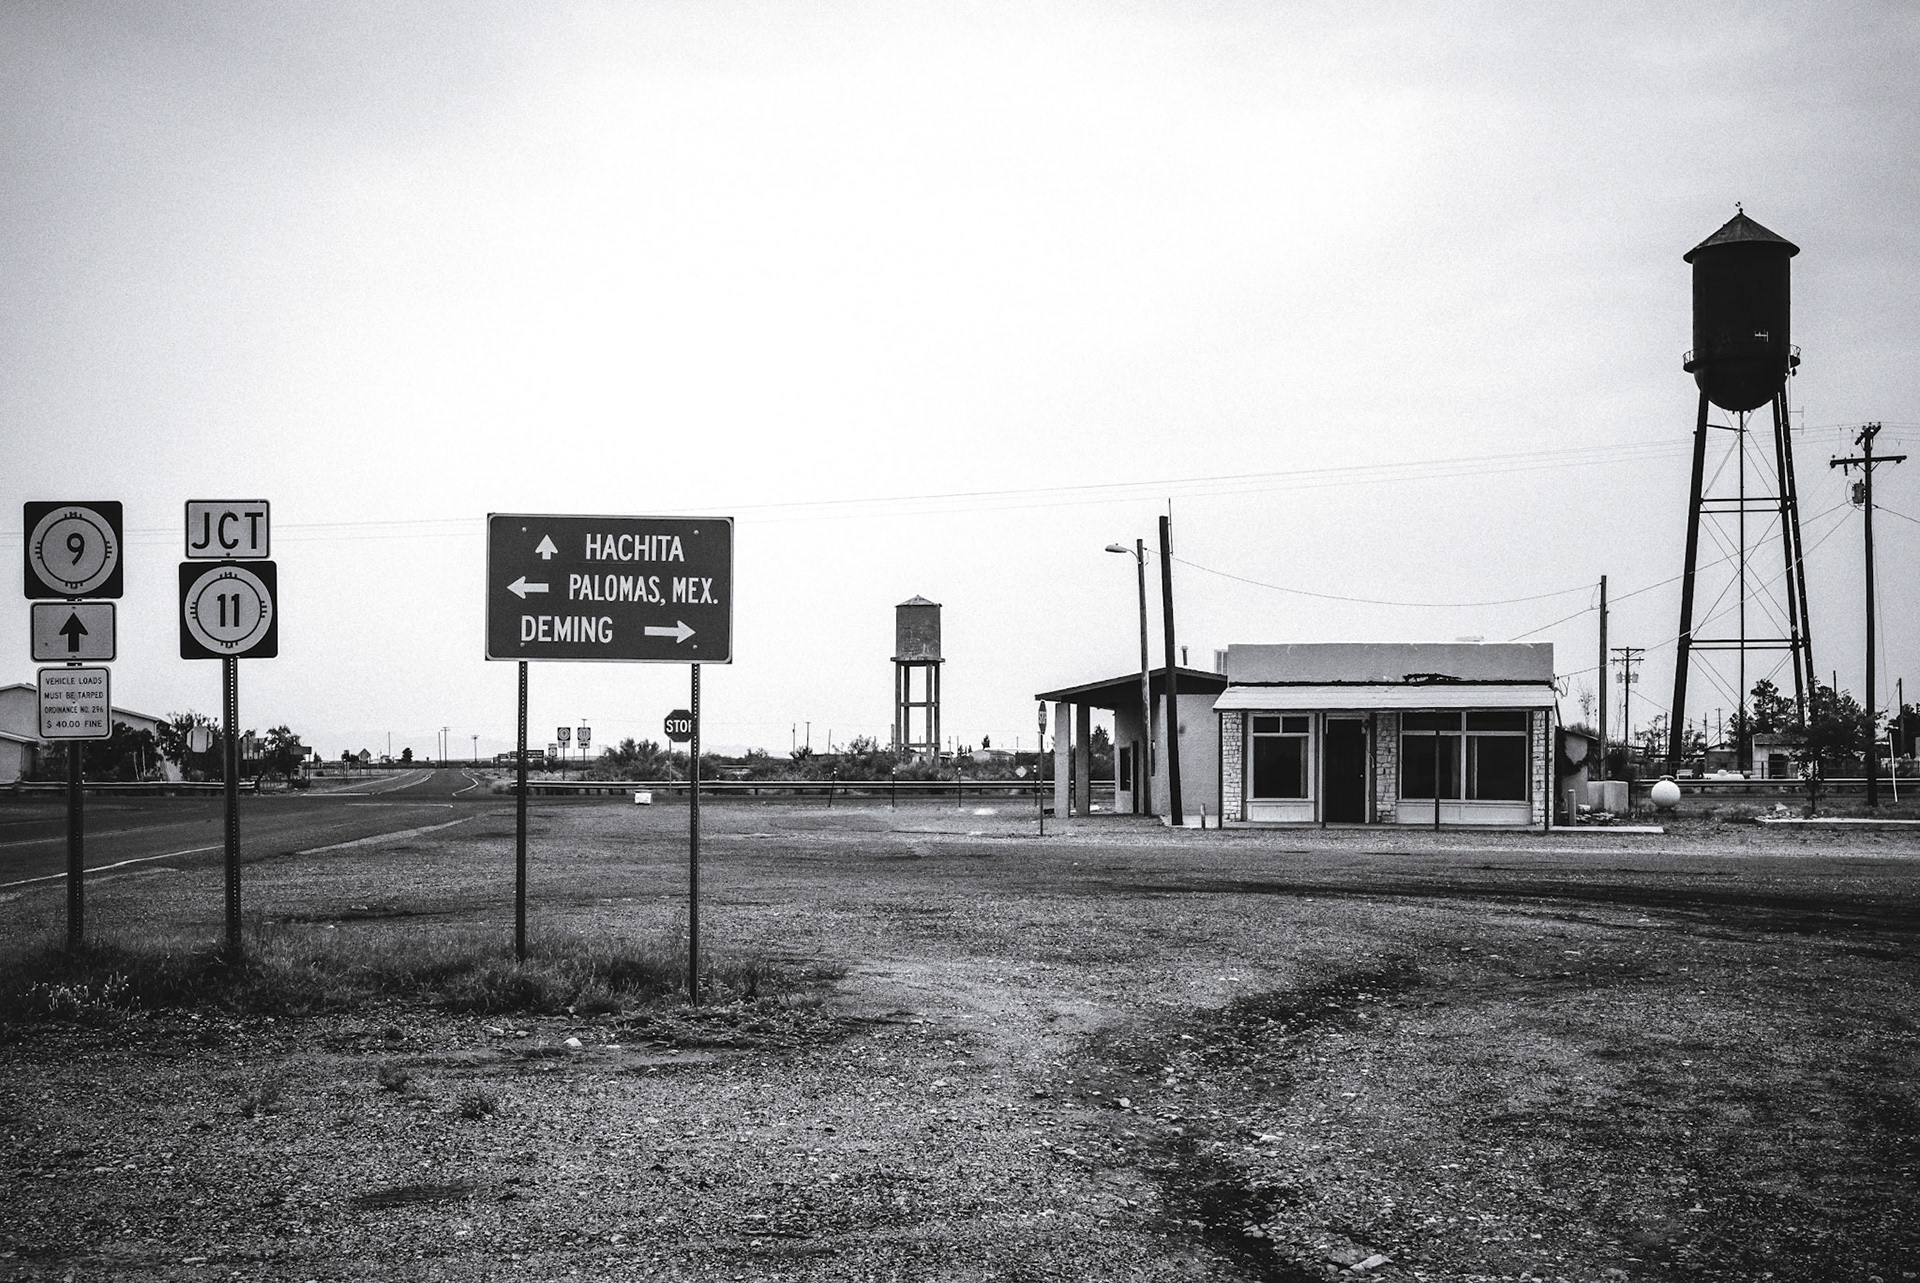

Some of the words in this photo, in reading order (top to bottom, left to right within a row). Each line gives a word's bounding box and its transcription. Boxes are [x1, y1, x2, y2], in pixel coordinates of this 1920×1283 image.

[191, 512, 264, 550] JCT
[66, 532, 85, 566] 9
[585, 533, 685, 562] HACHITA
[569, 574, 666, 606] PALOMAS,
[672, 577, 719, 604] MEX.
[217, 593, 240, 628] 11
[521, 615, 613, 644] DEMING
[44, 692, 63, 700] MUST
[66, 691, 75, 699] BE
[77, 691, 104, 699] TARPED
[45, 677, 76, 686] VEHICLE
[79, 677, 103, 685] LOADS
[44, 706, 78, 714] ORDINANCE
[55, 720, 81, 728] 40.00
[84, 720, 103, 728] FINE
